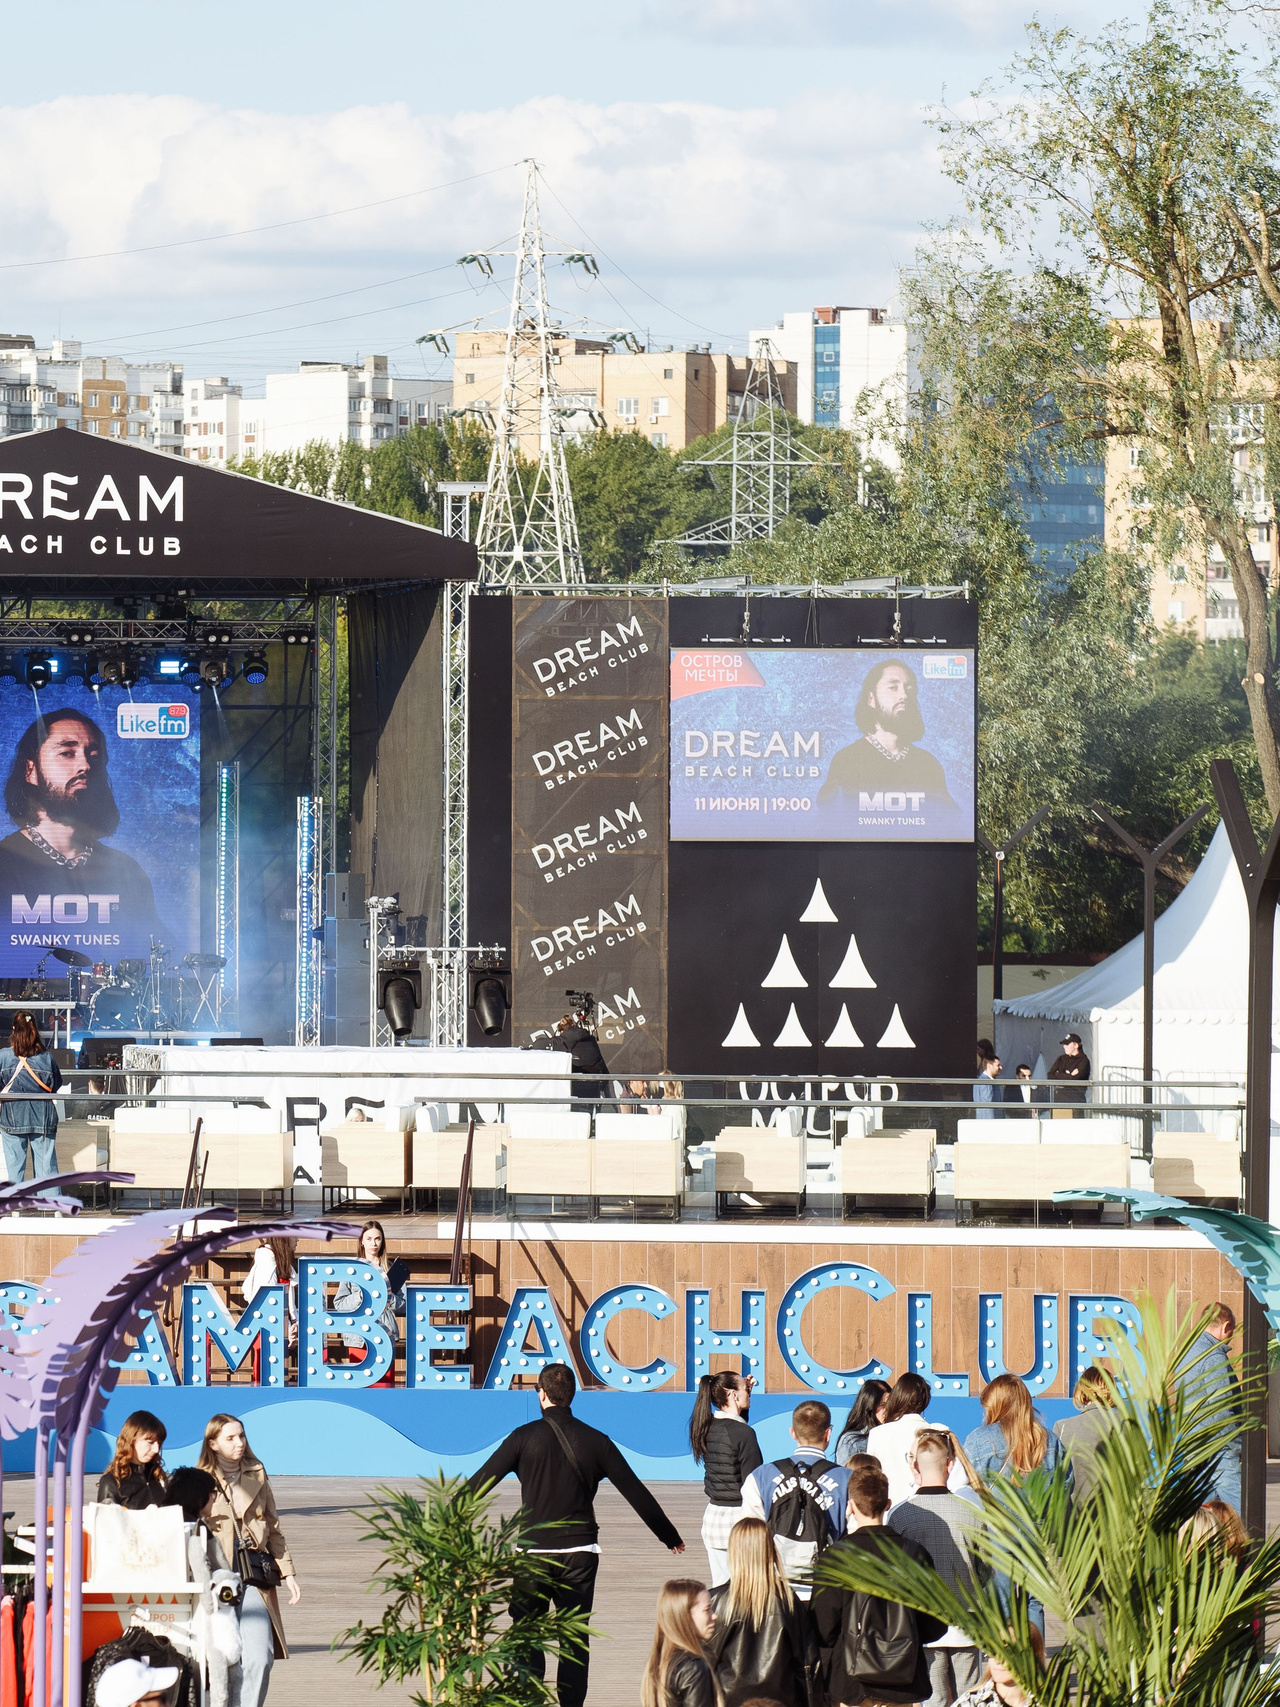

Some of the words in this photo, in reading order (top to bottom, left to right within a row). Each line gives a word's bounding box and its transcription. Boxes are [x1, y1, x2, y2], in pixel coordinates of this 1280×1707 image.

[91, 536, 180, 555] CLUB
[533, 616, 643, 682] DREAM
[681, 655, 743, 668] ОСТРОВ
[546, 667, 598, 697] BEACH
[609, 643, 649, 667] CLUB
[685, 670, 738, 682] МЕЧТЫ
[120, 715, 157, 732] Like
[532, 709, 643, 775] DREAM
[685, 730, 820, 758] DREAM
[545, 759, 597, 790] BEACH
[608, 736, 648, 760] CLUB
[685, 766, 752, 777] BEACH
[767, 766, 819, 777] CLUB
[694, 797, 706, 810] 11
[709, 797, 760, 811] ИЮНЯ
[771, 797, 811, 811] 19:00
[858, 817, 896, 826] SWANKY
[897, 817, 926, 826] TUNES
[532, 802, 642, 868] DREAM
[544, 852, 597, 882] BEACH
[607, 829, 647, 853] CLUB
[10, 934, 71, 946] SWANKY
[74, 934, 120, 946] TUNES
[531, 895, 641, 961] DREAM
[544, 945, 596, 976] BEACH
[606, 922, 647, 946] CLUB
[606, 1015, 646, 1040] CLUB
